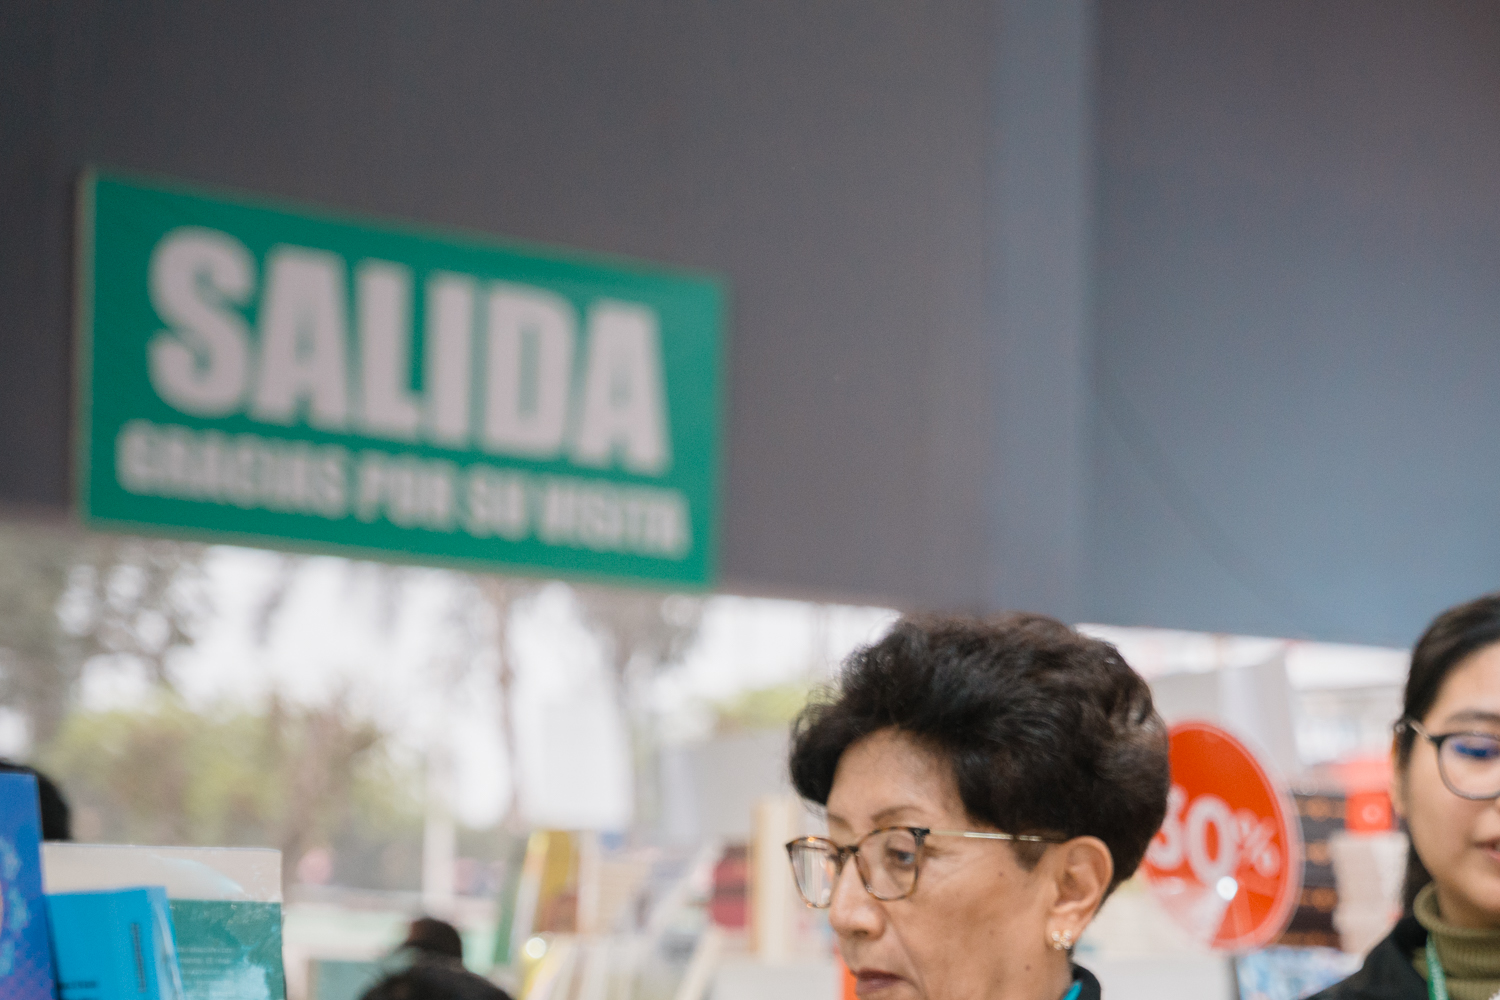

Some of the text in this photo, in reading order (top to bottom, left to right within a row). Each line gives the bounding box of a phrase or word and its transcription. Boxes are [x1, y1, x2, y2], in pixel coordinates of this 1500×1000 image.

[147, 224, 672, 477] SALIDA
[115, 418, 693, 562] GRACIAS POR SU VISITA
